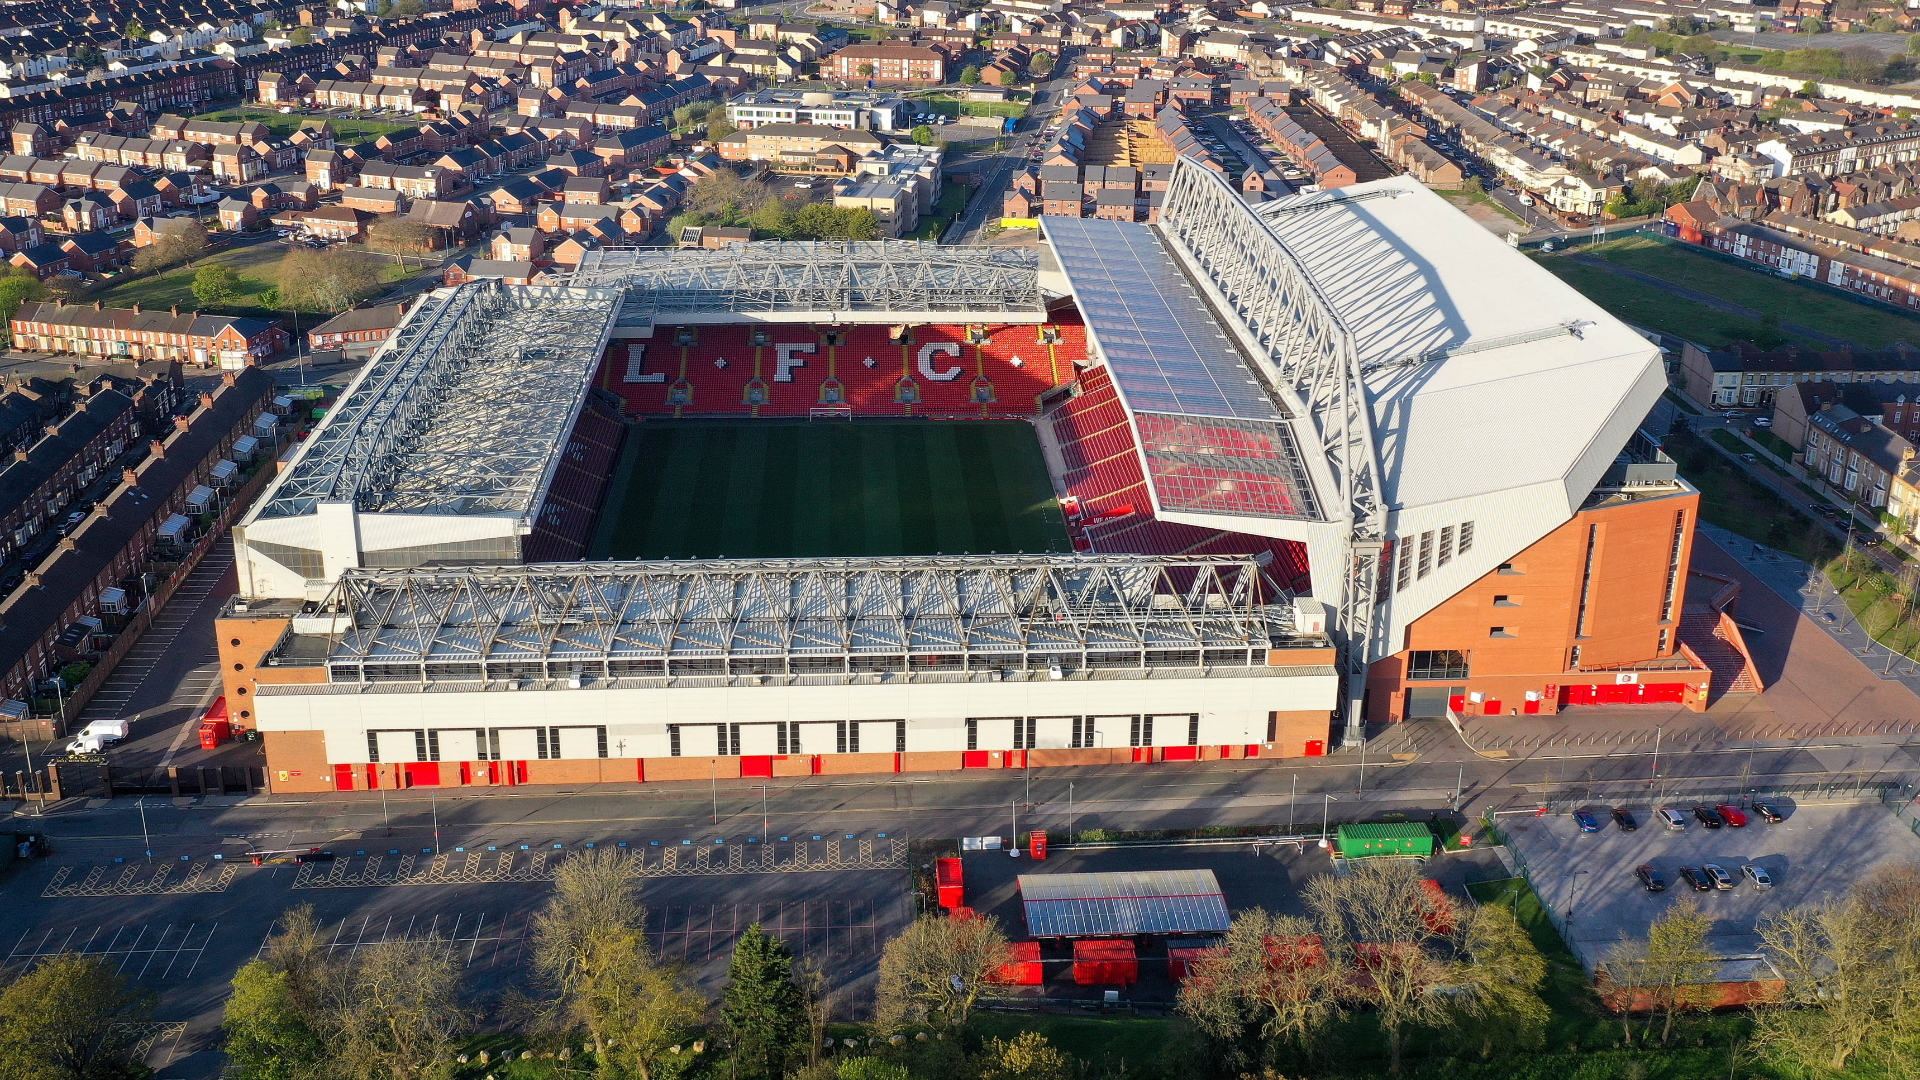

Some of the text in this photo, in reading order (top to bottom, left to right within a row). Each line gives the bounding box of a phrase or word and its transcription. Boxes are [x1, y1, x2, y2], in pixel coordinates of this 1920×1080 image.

[624, 342, 961, 382] L F C
